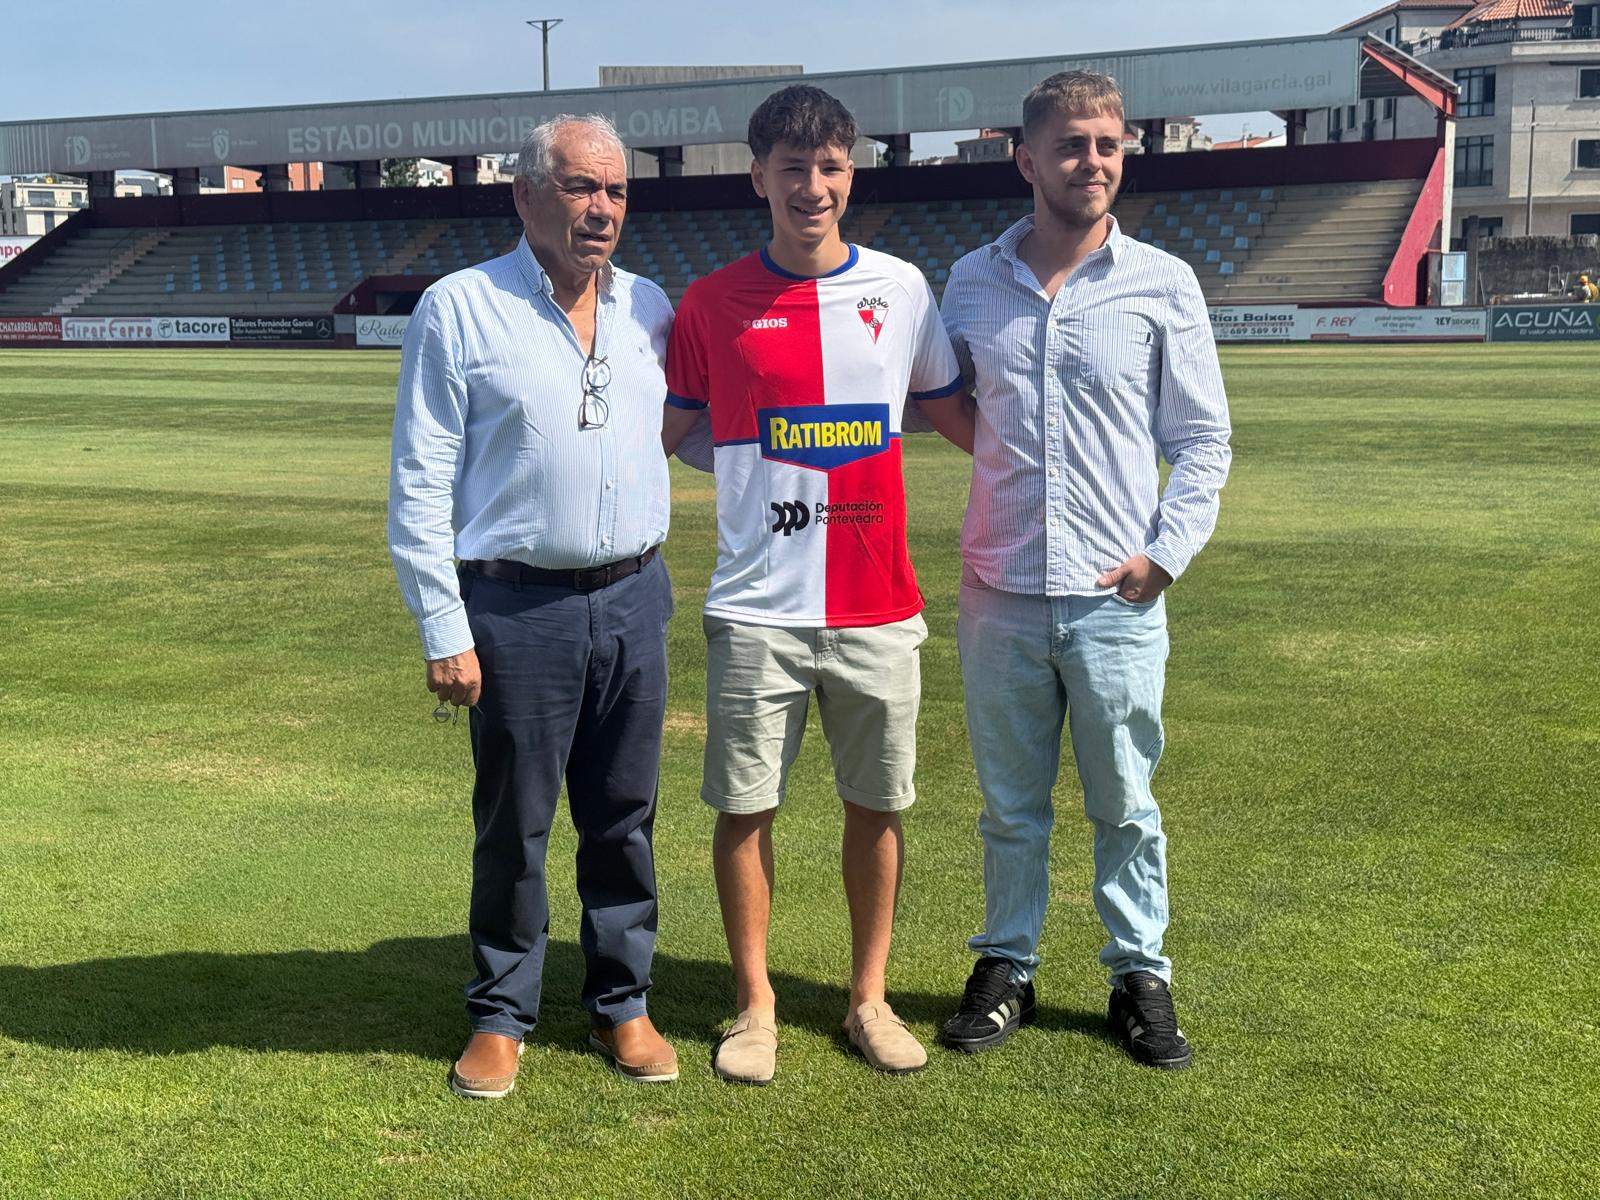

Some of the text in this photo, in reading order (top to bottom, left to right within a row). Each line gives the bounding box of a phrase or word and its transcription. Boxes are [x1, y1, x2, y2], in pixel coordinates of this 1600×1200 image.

[287, 121, 403, 154] ESTADIO
[412, 114, 549, 149] MUNICIP
[231, 319, 257, 328] Talleres
[751, 317, 788, 330] GIOS
[1243, 313, 1294, 322] Baixas
[1331, 316, 1357, 328] REY
[1494, 308, 1593, 328] ACUÑA
[38, 321, 54, 333] DITO
[175, 320, 227, 334] tacore
[769, 416, 882, 450] RATIBROM
[815, 500, 884, 514] Deputación
[815, 513, 884, 525] Pontevedra
